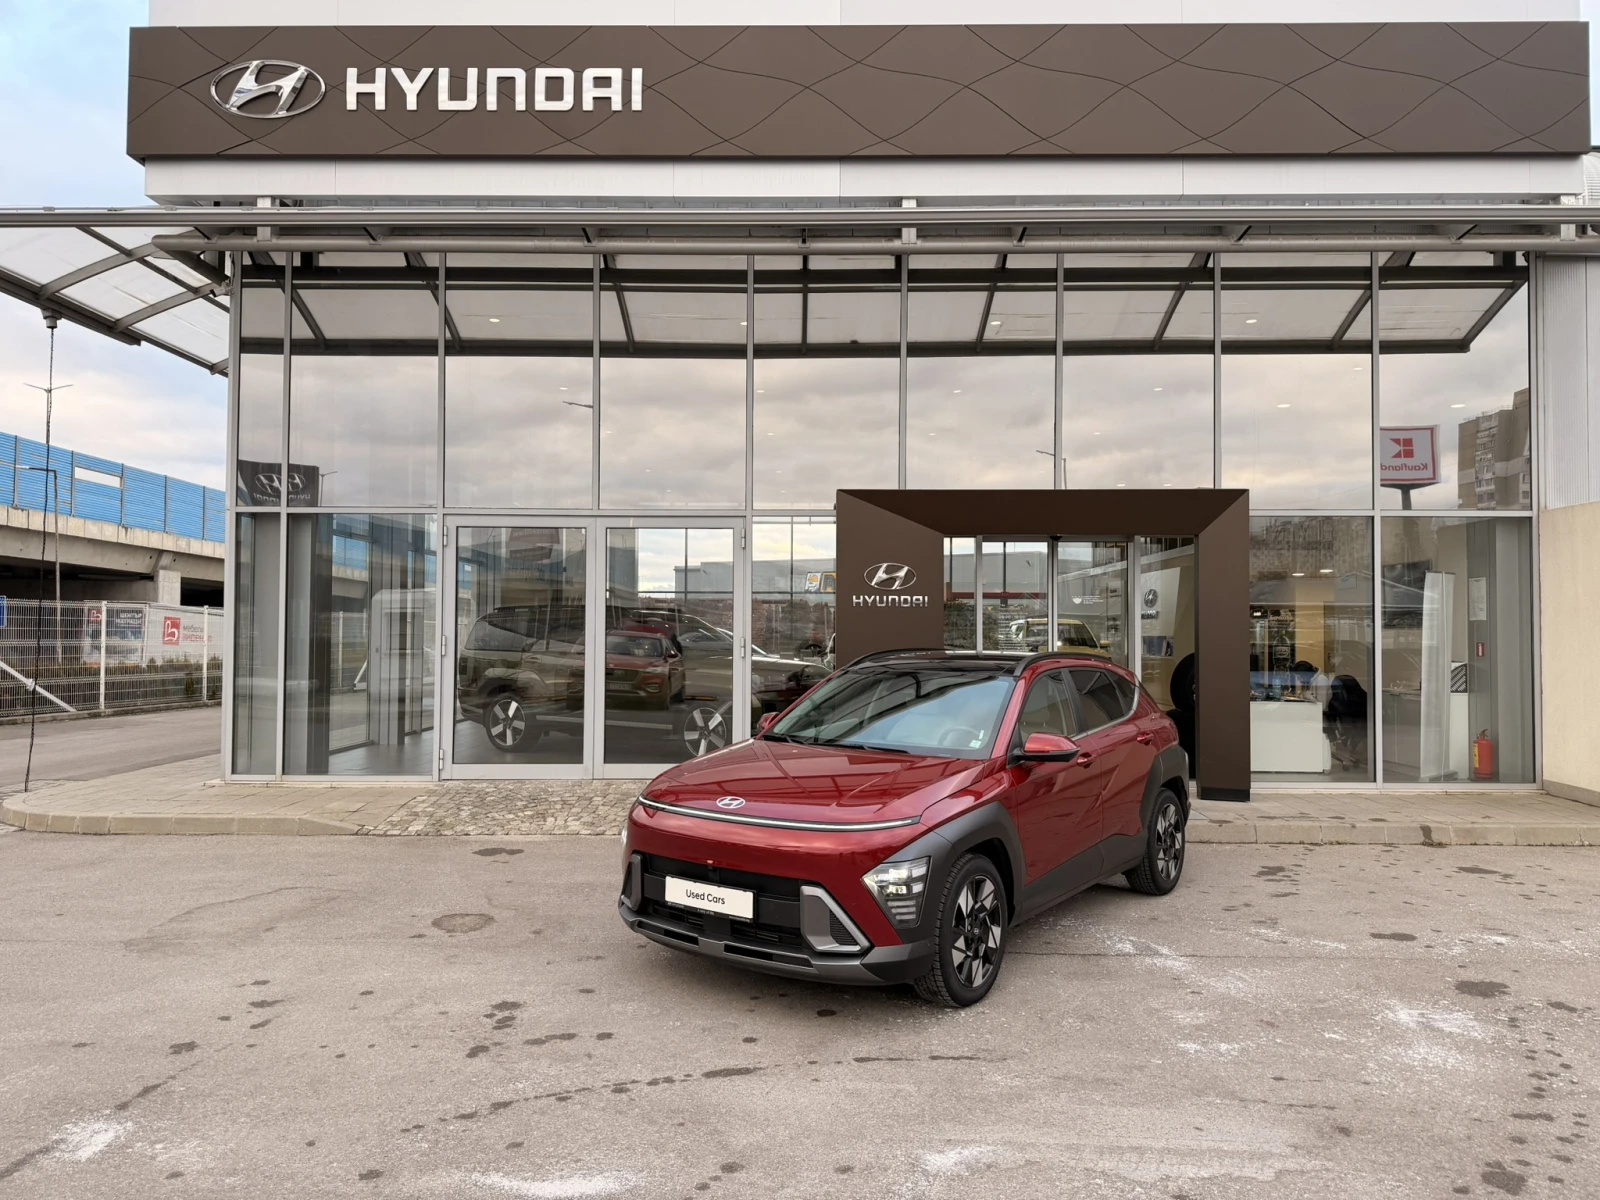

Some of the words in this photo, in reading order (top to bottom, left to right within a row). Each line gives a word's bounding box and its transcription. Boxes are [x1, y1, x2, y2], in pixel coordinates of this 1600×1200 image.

[346, 67, 643, 111] HYUNDAI
[852, 595, 929, 607] HYUNDAI
[685, 888, 705, 901] Used
[706, 893, 726, 905] Cars
